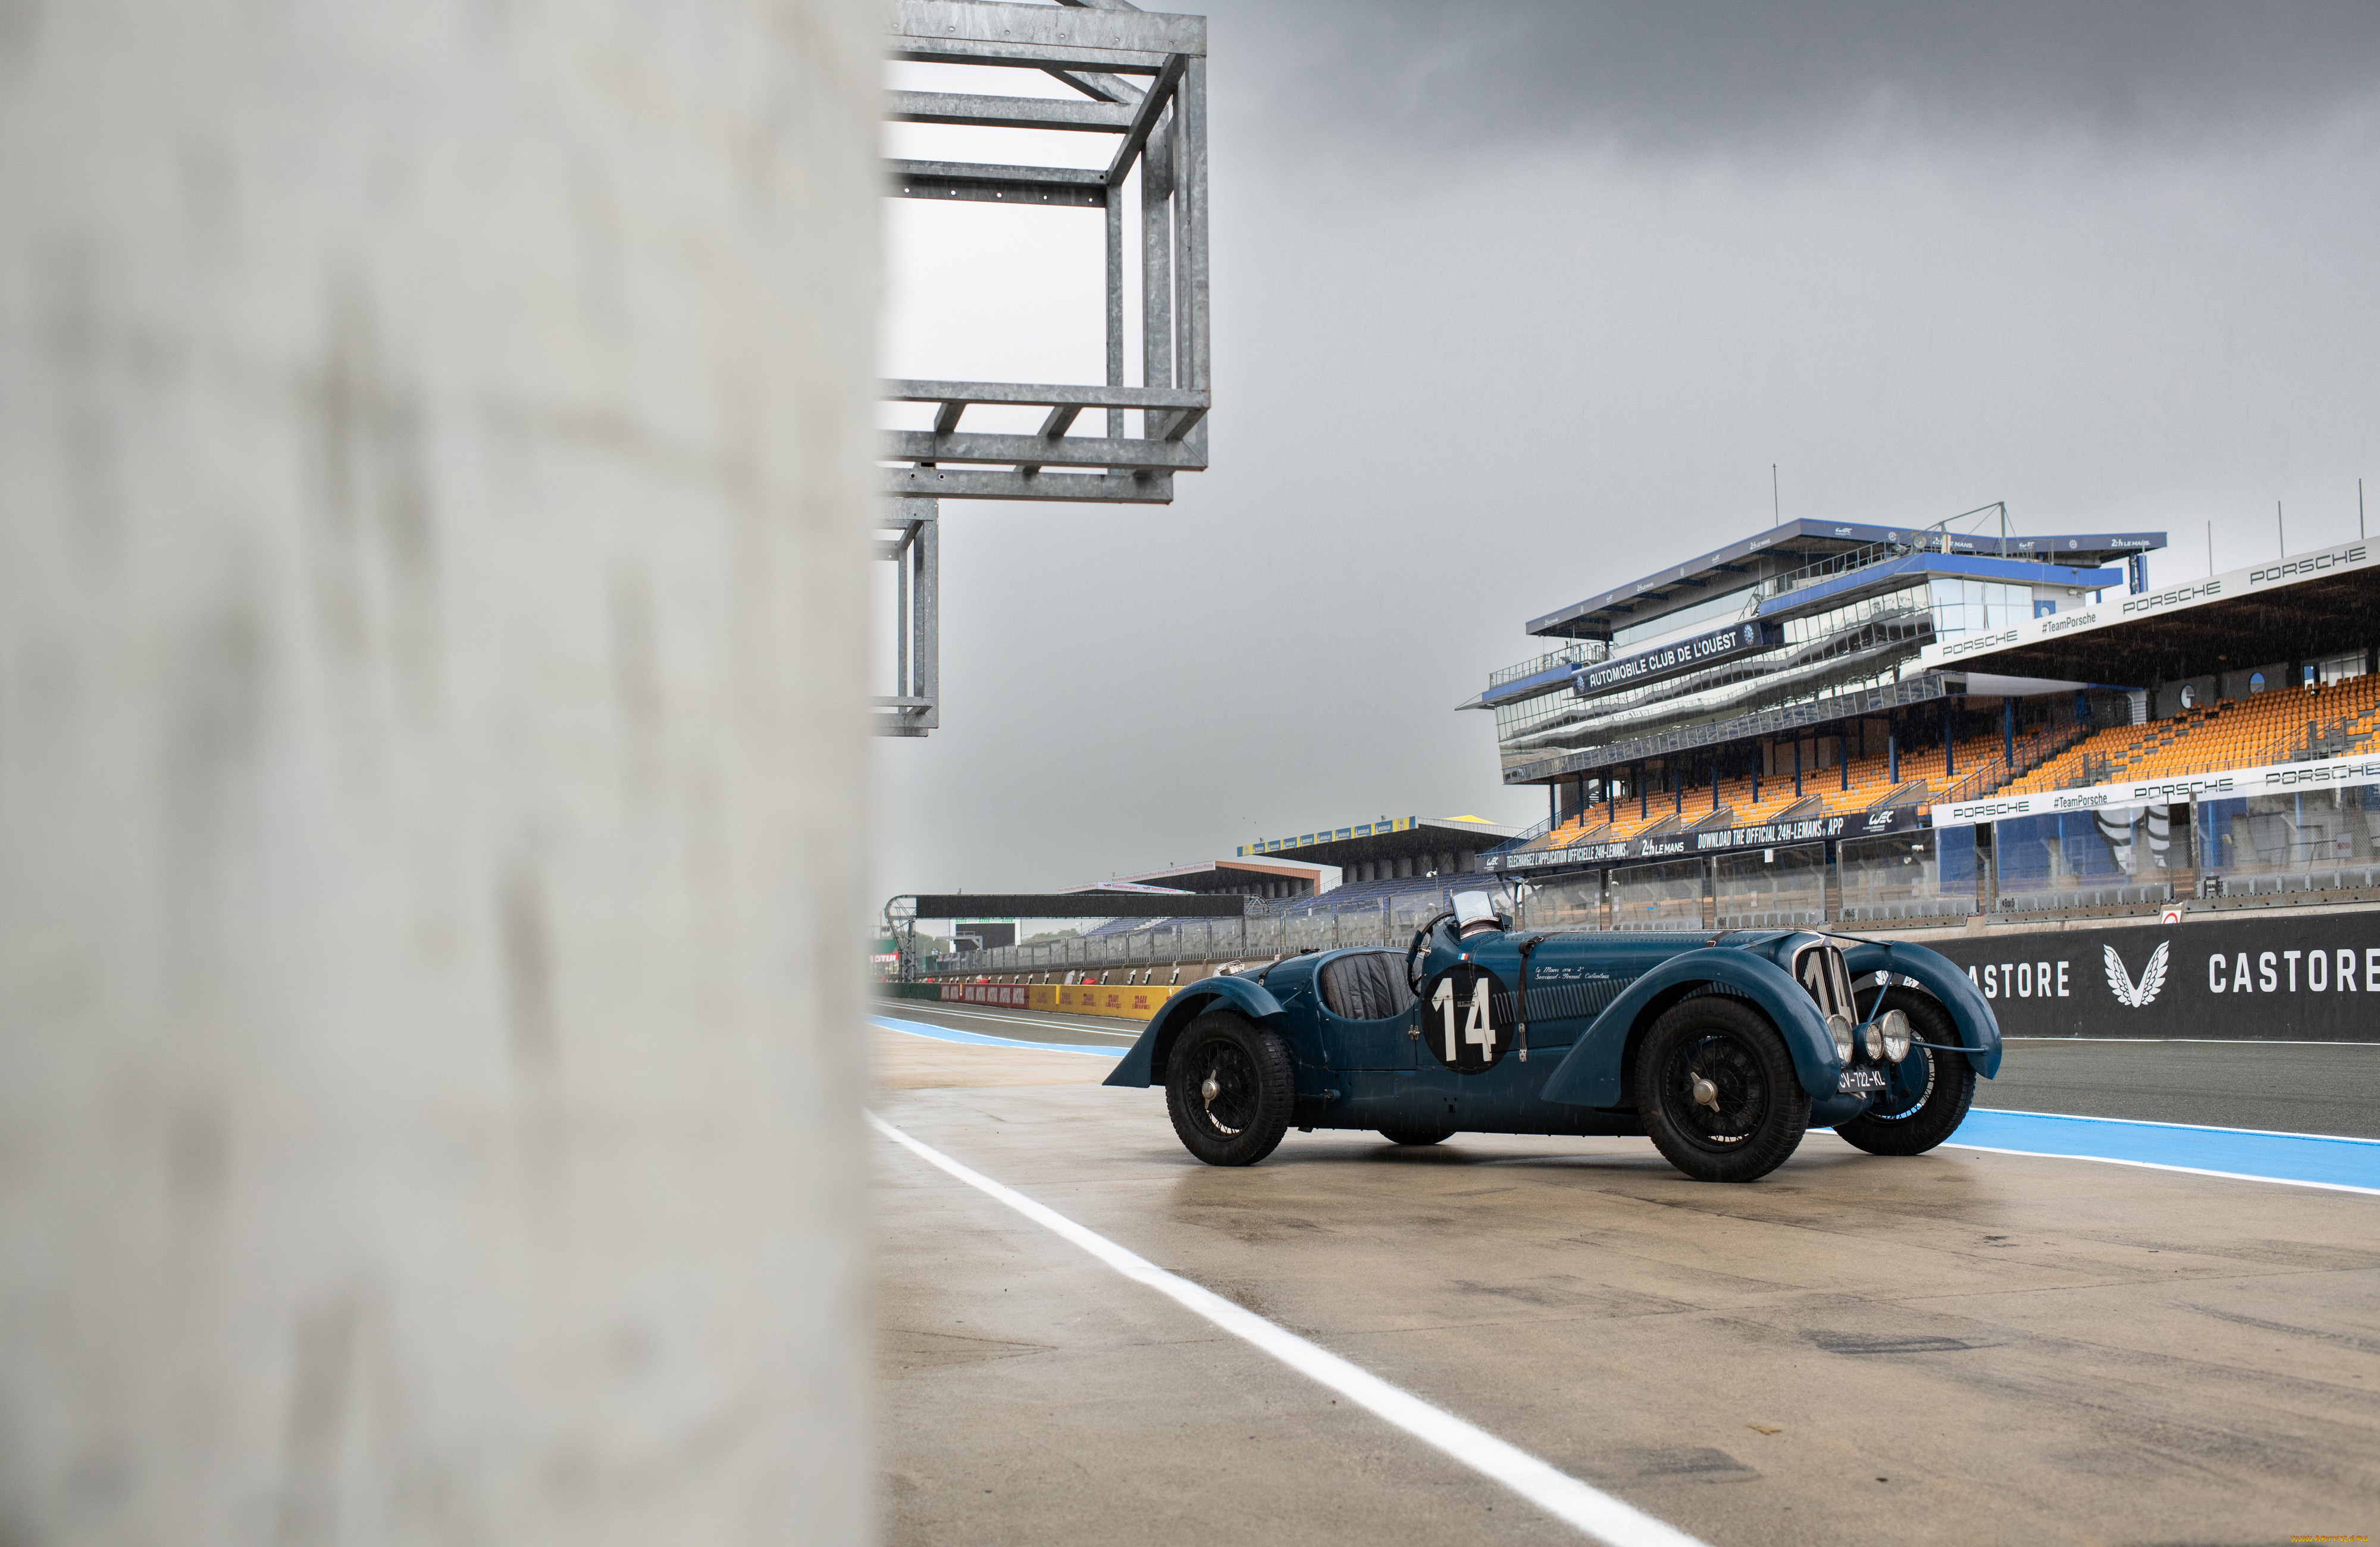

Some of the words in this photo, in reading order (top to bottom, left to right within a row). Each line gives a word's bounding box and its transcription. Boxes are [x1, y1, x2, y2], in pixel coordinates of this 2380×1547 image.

[2250, 547, 2366, 585] PORSCHE
[2123, 581, 2221, 615] PORSCHE
[2042, 612, 2096, 634] #TeamPorsche
[1943, 630, 2018, 657] PORSCHE
[1590, 659, 1647, 687] AUTOMOBILE
[1649, 651, 1675, 670] CLUB
[1677, 646, 1692, 662] DE
[1693, 632, 1736, 657] L'OUEST
[2266, 763, 2380, 786] PORSCHE
[1954, 801, 2030, 819] PORSCHE
[2053, 794, 2107, 808] #TeamPorsche
[1869, 811, 1894, 825] WEC
[1698, 832, 1731, 849] DOWNLOAD
[1733, 830, 1745, 845] THE
[1746, 825, 1775, 844] OFFICIAL
[1828, 818, 1843, 835] APP
[1507, 855, 1534, 868] TELECHARGEZ
[1535, 850, 1567, 865] L'APPLICATION
[1568, 846, 1594, 862] OFFICIELLE
[1655, 844, 1663, 854] LE
[1664, 842, 1684, 853] MANS
[1486, 857, 1499, 866] WEC
[1969, 961, 2069, 998] ASTORE
[2209, 948, 2380, 992] CASTORE
[1133, 995, 1150, 1010] DHL
[1432, 978, 1496, 1061] 14
[1840, 1070, 1886, 1088] CV-722-KL
